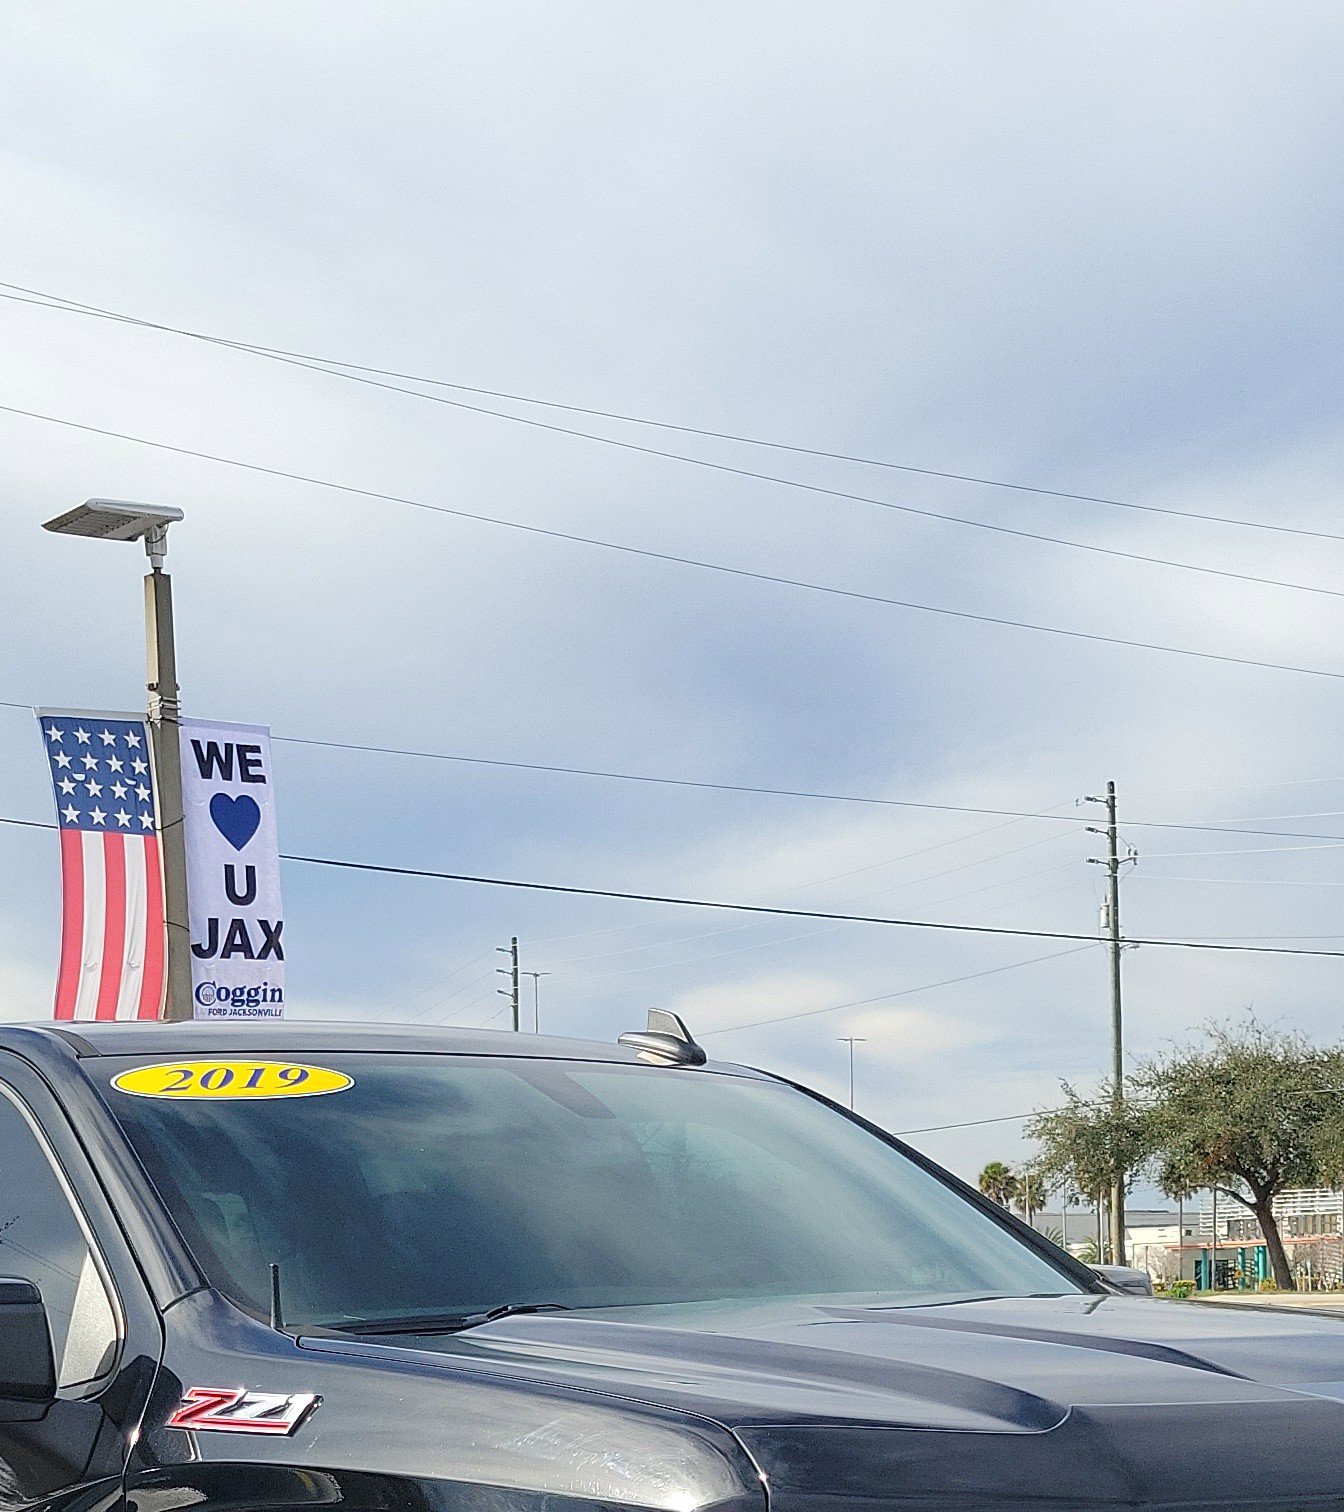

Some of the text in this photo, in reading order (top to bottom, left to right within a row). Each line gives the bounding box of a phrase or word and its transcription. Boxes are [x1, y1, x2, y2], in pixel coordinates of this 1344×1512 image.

[190, 739, 267, 785] WE
[223, 864, 257, 906] U
[191, 918, 285, 961] JAX
[195, 980, 283, 1008] Coggin
[208, 1008, 282, 1017] FORD JACKSONVILLE
[158, 1067, 310, 1093] 2019
[164, 1386, 323, 1437] Z71
